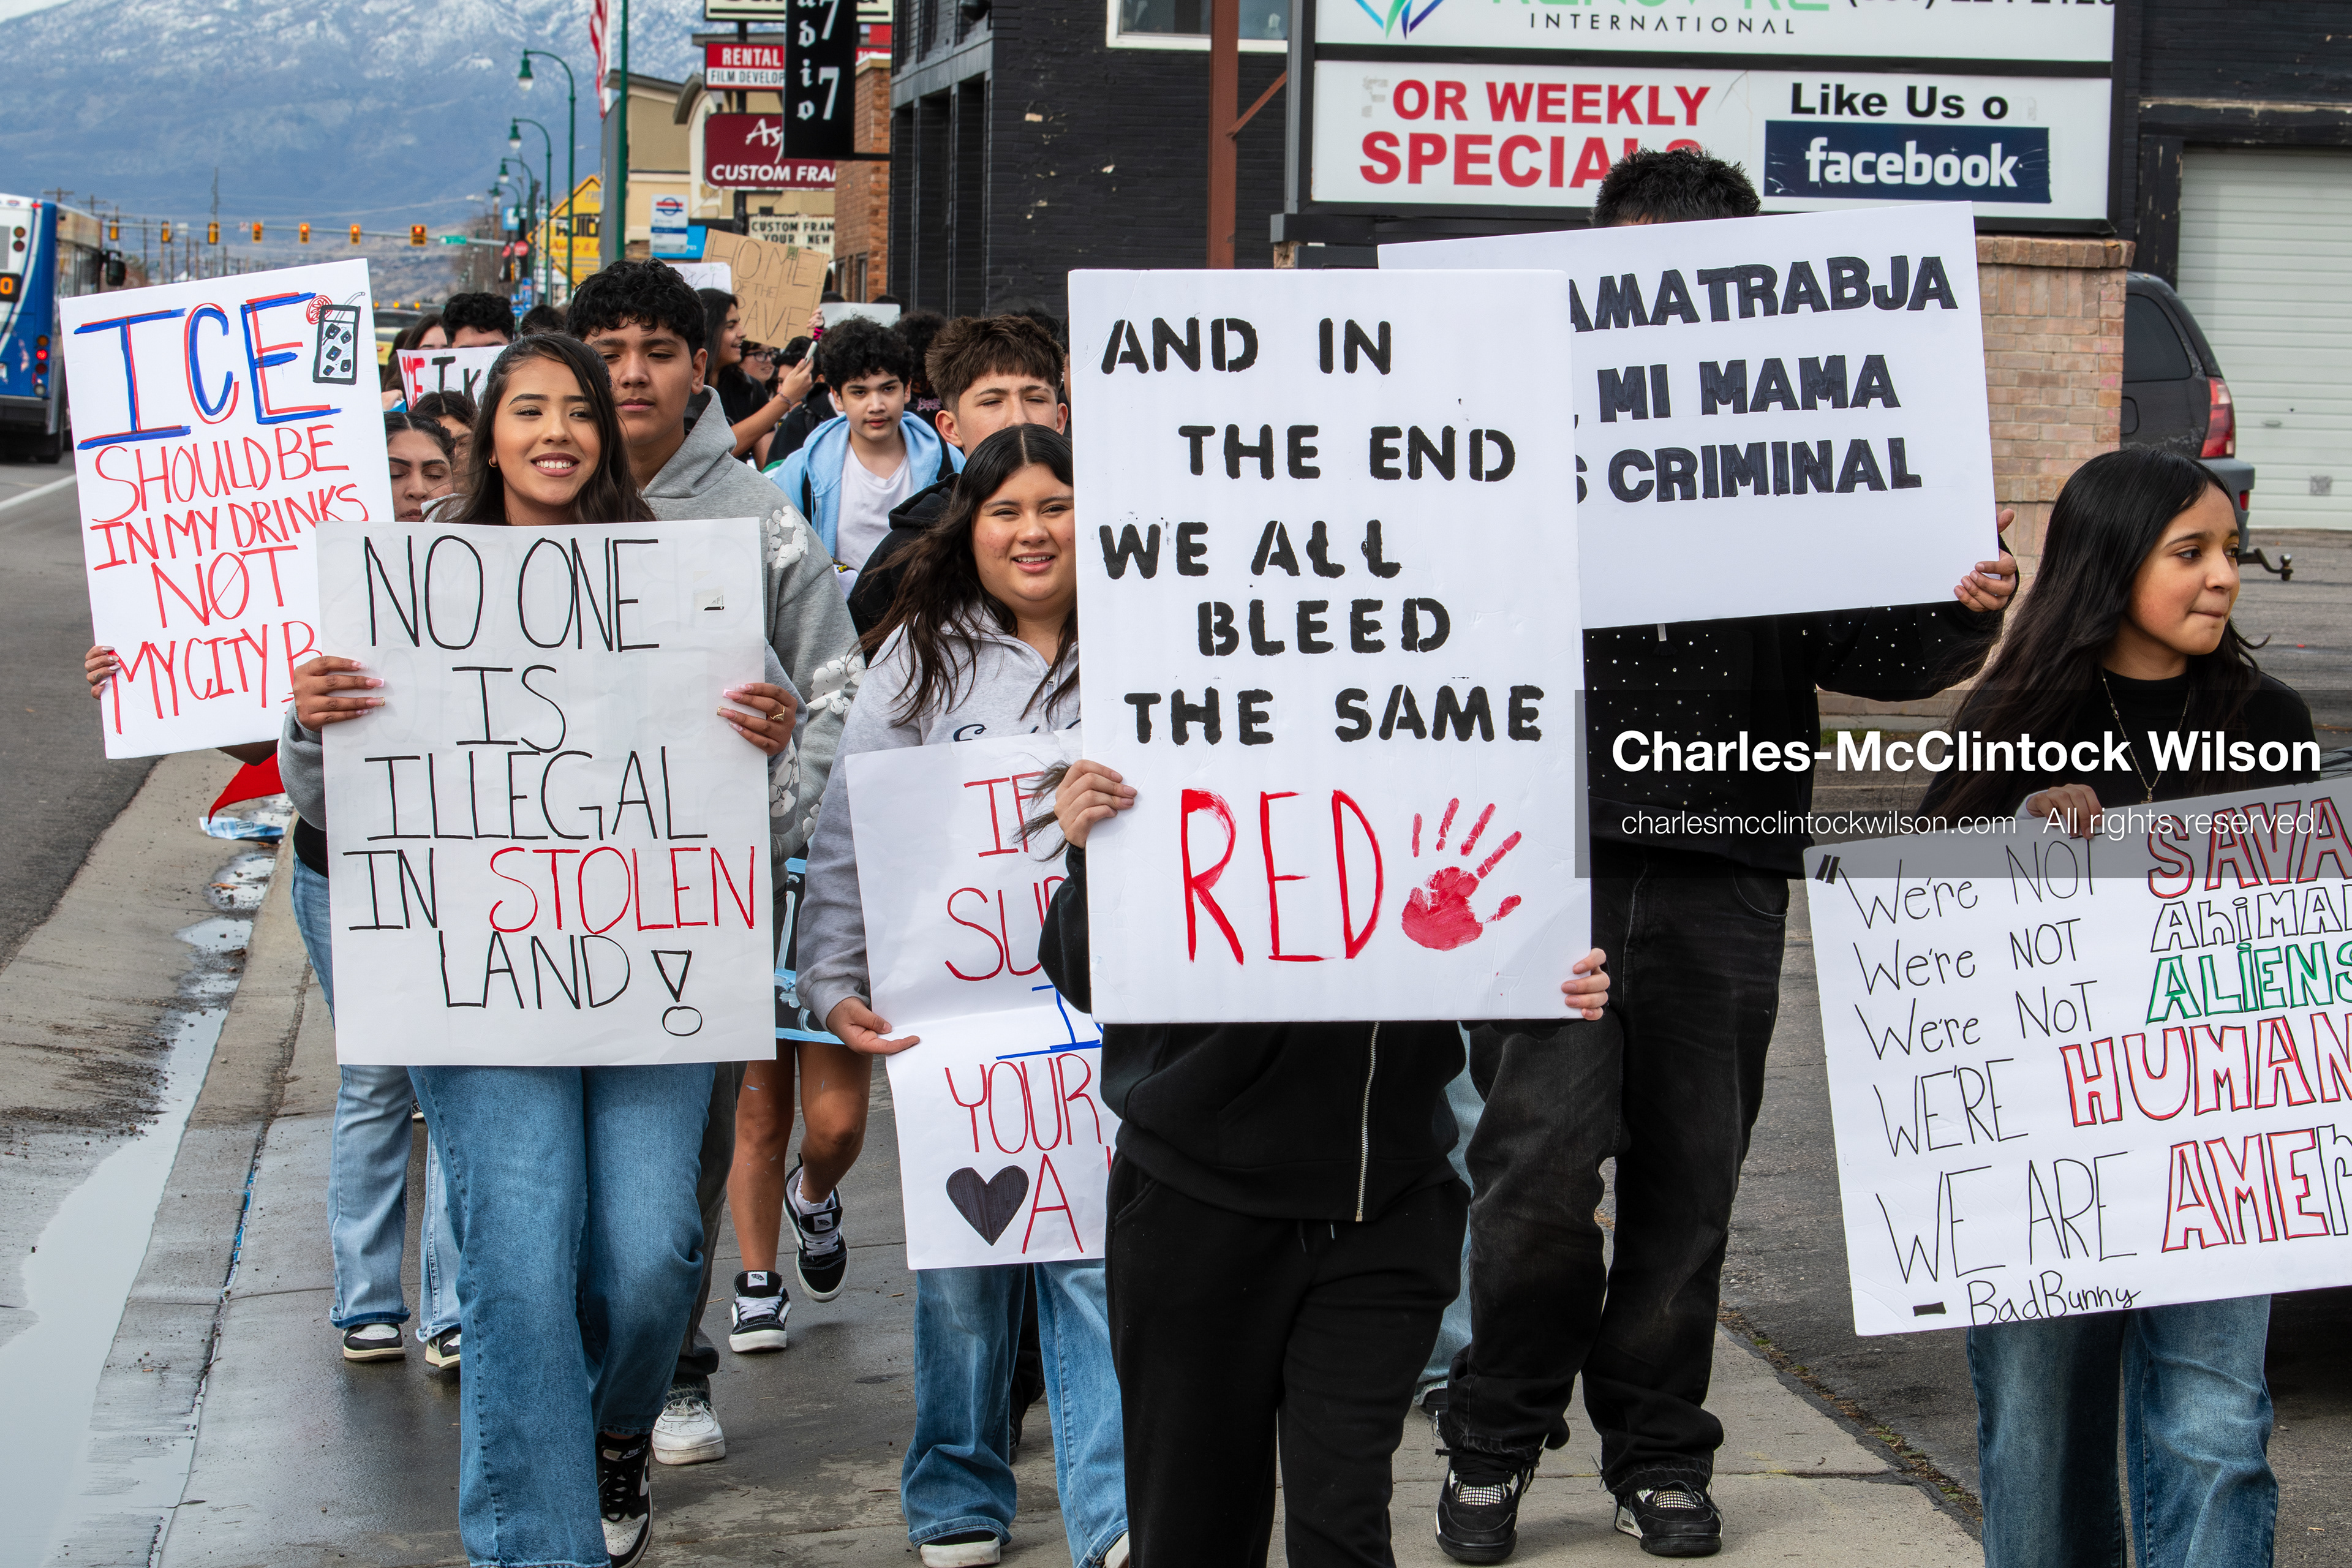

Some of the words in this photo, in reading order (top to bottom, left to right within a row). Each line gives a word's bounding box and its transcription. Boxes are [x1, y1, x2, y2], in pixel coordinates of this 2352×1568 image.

[1531, 13, 1795, 34] INTERNATIONAL
[711, 70, 734, 82] FILM
[722, 47, 781, 67] RENTAL
[1487, 82, 1709, 126] WEEKLY
[1791, 83, 1888, 116] Like
[1907, 86, 1964, 119] Us
[712, 164, 791, 181] CUSTOM
[1805, 137, 2018, 187] facebook
[752, 221, 797, 232] CUSTOM
[764, 233, 795, 244] YOUR
[807, 234, 830, 244] NEW
[754, 283, 778, 299] THE
[74, 292, 344, 451] ICE
[1101, 317, 1258, 374] AND
[1319, 318, 1391, 375] IN
[1597, 364, 1672, 423] MI
[1698, 354, 1901, 416] MAMA
[94, 436, 271, 523] SHOULD
[276, 424, 350, 481] BE
[1178, 424, 1321, 481] THE
[1370, 425, 1515, 482] END
[1608, 437, 1923, 503] CRIMINAL
[90, 517, 158, 571] IN
[165, 506, 219, 559] MY
[230, 483, 369, 548] DRINKS
[1099, 522, 1209, 580] WE
[1251, 519, 1403, 579] ALL
[151, 544, 299, 629] NOT
[364, 535, 484, 650] NO
[518, 537, 660, 653] ONE
[1197, 597, 1450, 657] BLEED
[110, 640, 179, 735] MY
[185, 623, 268, 709] CITY
[451, 665, 567, 753] IS
[1124, 686, 1274, 746] THE
[1335, 684, 1544, 742] SAME
[364, 744, 708, 842] ILLEGAL
[342, 847, 438, 931] IN
[489, 846, 755, 935] STOLEN
[1180, 788, 1384, 966] RED
[2006, 832, 2105, 905] NOT
[944, 875, 1066, 981] SU
[2009, 918, 2082, 970] NOT
[944, 1052, 1102, 1154] YOUR
[1875, 1165, 2007, 1285] WE
[2028, 1151, 2138, 1265] ARE
